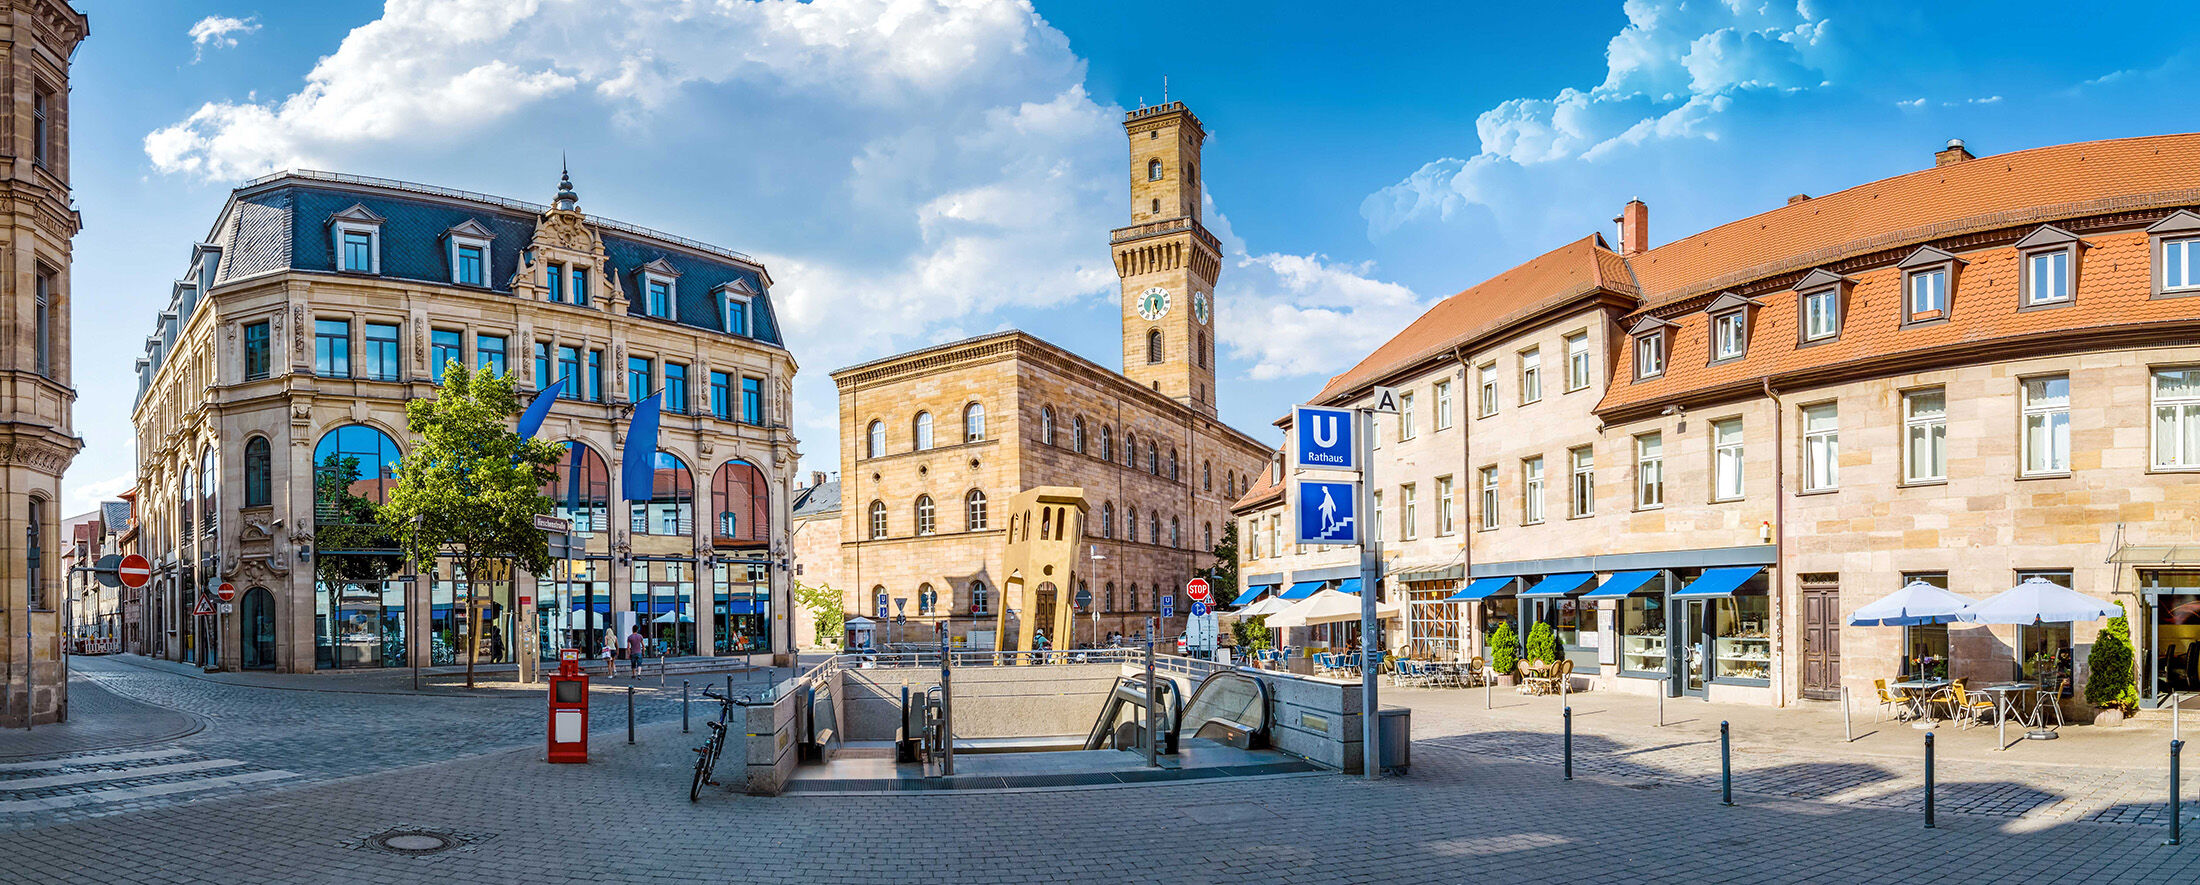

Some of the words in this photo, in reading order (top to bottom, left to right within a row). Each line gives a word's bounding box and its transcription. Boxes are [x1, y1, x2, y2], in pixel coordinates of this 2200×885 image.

[1379, 390, 1396, 411] A
[1312, 415, 1338, 448] U
[1308, 452, 1344, 463] Rathaus
[1189, 584, 1207, 594] STOP
